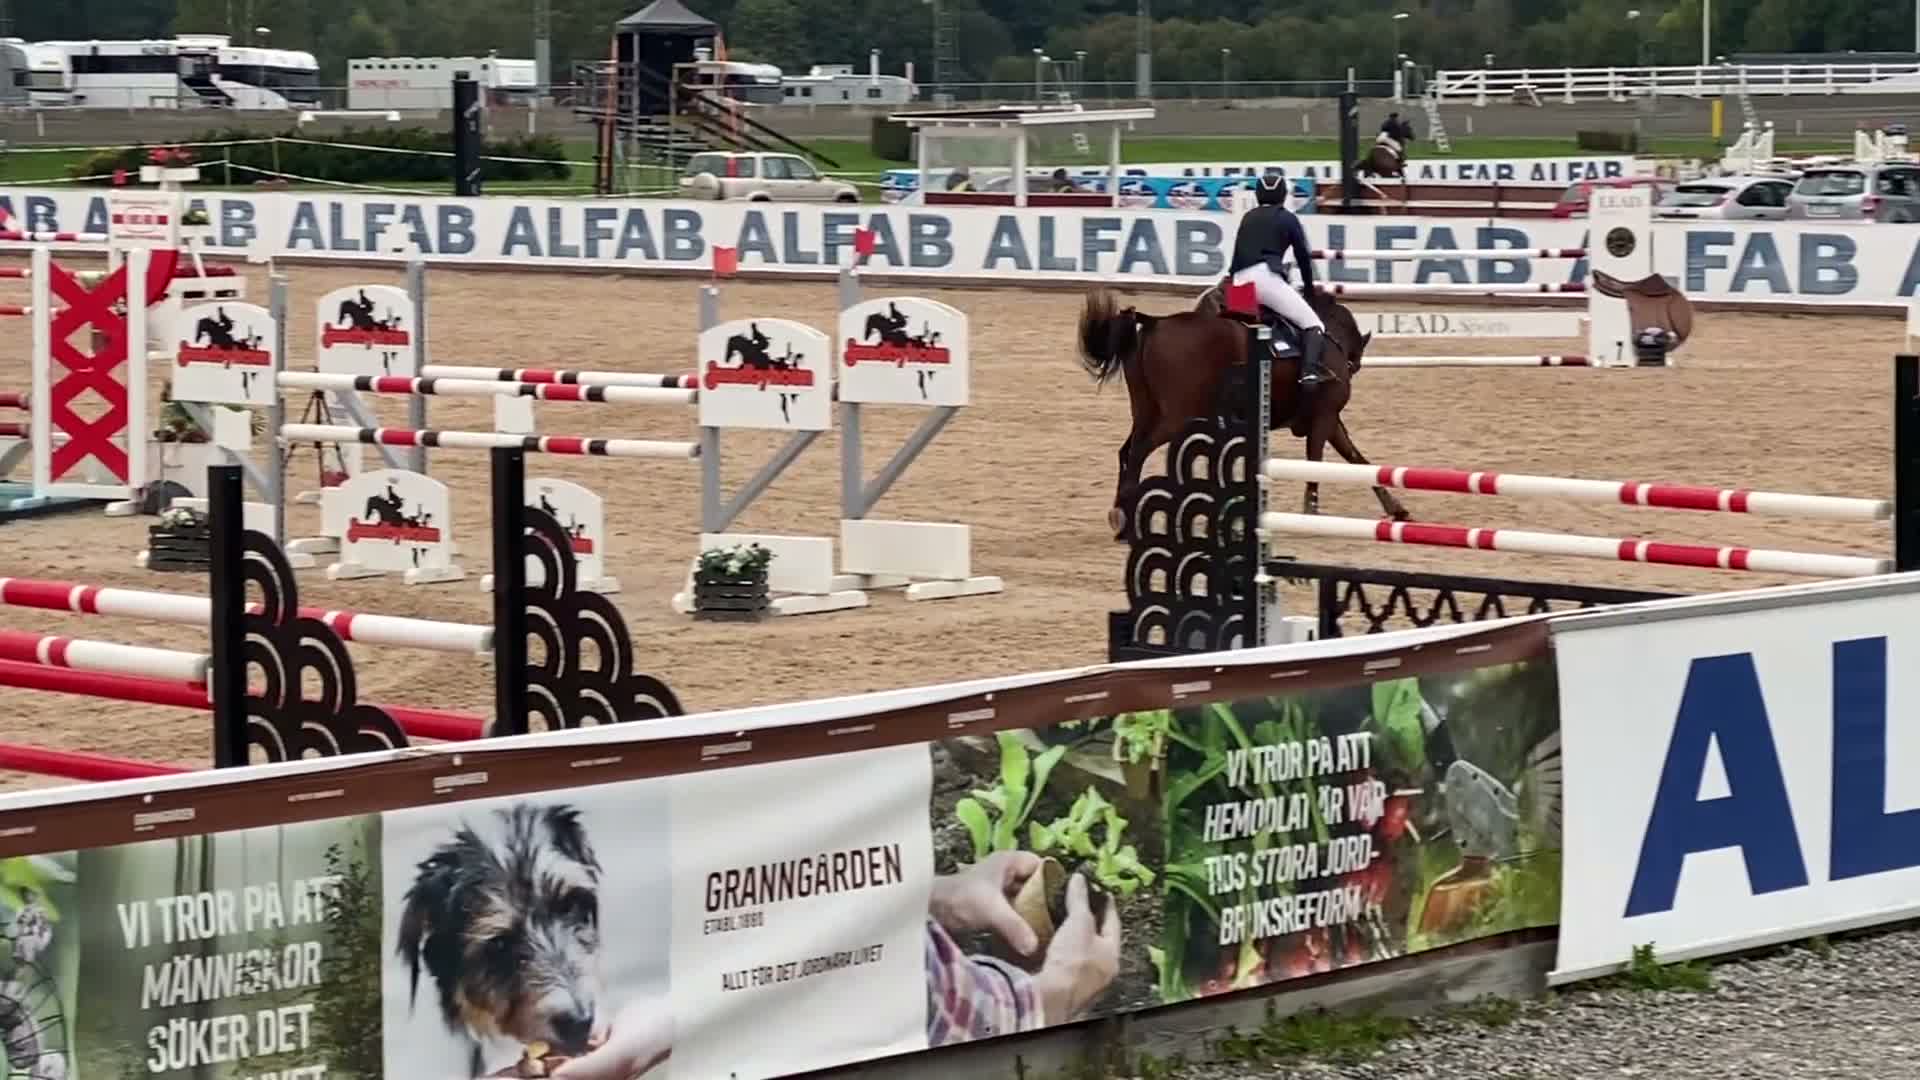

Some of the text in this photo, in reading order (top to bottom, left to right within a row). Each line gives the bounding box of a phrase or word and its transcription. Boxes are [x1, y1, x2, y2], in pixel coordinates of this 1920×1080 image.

[286, 201, 476, 254] ALFAB
[501, 206, 706, 262] ALFAB
[737, 210, 955, 268] ALFAB
[982, 215, 1226, 277] ALFAB
[1310, 224, 1533, 284] LFAB
[1227, 731, 1374, 787] VI TROR PÅ ATT
[1623, 636, 1920, 919] AL
[1318, 784, 1345, 825] ÄR
[705, 843, 904, 913] GRANNGÅRDEN
[1204, 833, 1380, 896] TIDS STORA JORD-
[117, 901, 150, 949] VI
[155, 889, 238, 944] TROR
[245, 882, 285, 932] PÅ
[141, 941, 323, 1010] MÄNNISKOR
[722, 970, 749, 992] ALLT
[752, 966, 774, 987] FÖR
[776, 961, 798, 982] DET
[853, 943, 884, 966] LIVET
[147, 1003, 316, 1074] SÖKER DET
